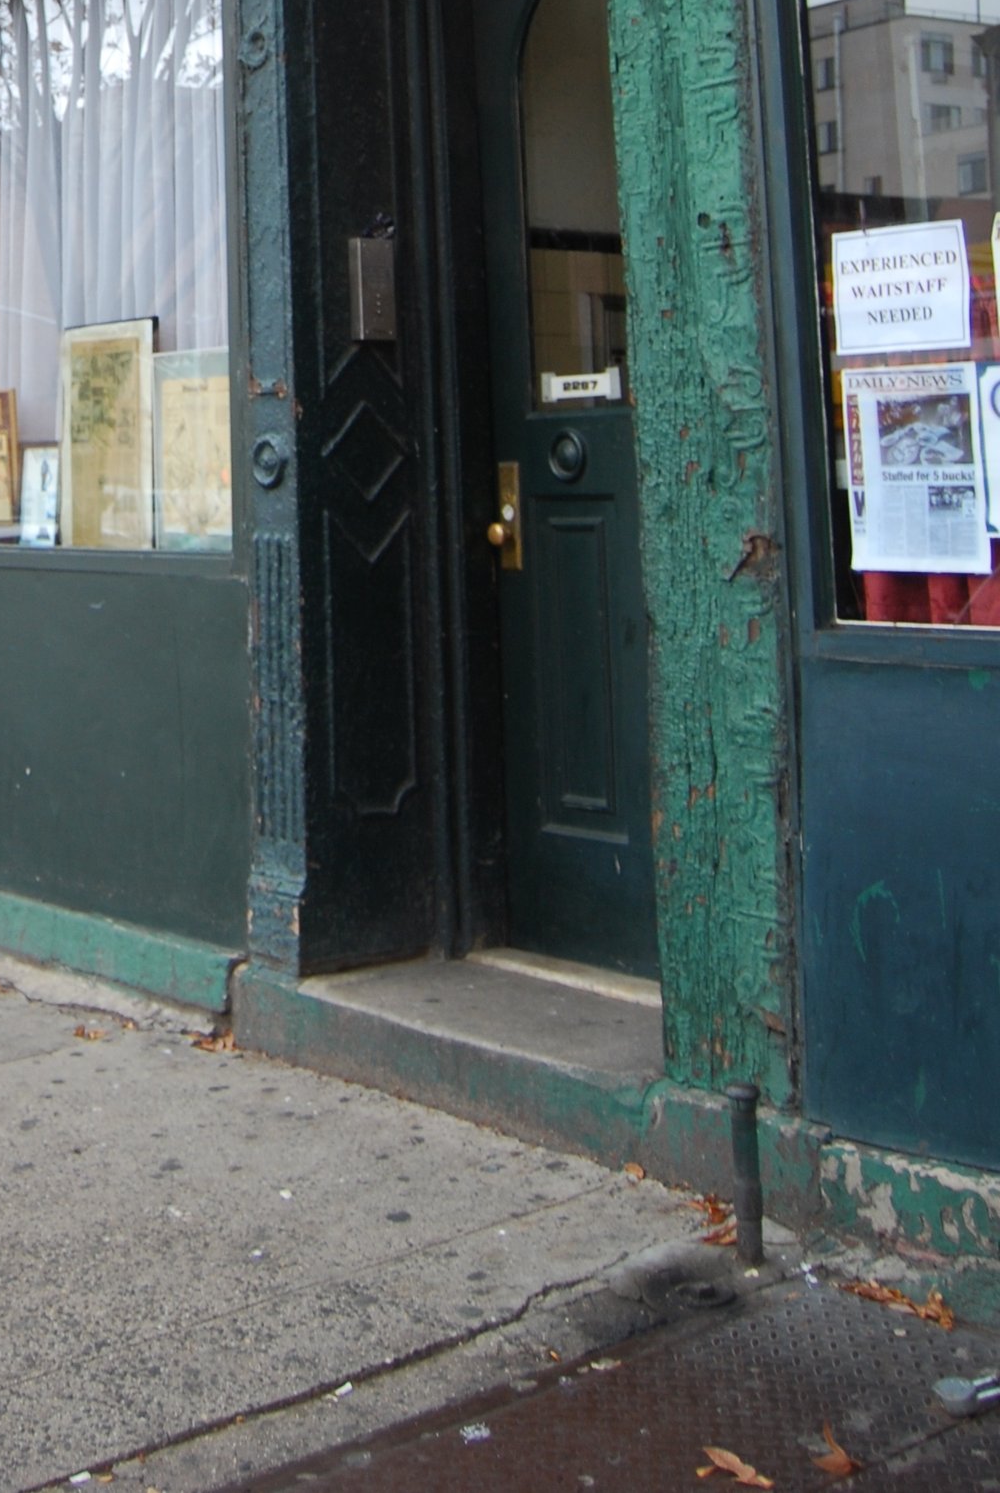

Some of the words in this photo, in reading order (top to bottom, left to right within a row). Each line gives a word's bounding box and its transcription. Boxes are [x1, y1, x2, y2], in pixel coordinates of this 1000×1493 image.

[839, 249, 957, 275] EXPERIENCED
[851, 277, 948, 299] WAITSTAFF
[867, 305, 933, 325] NEEDED
[847, 377, 898, 390] DAILY
[906, 374, 964, 388] NEWS
[916, 471, 930, 481] for
[933, 470, 940, 481] 5
